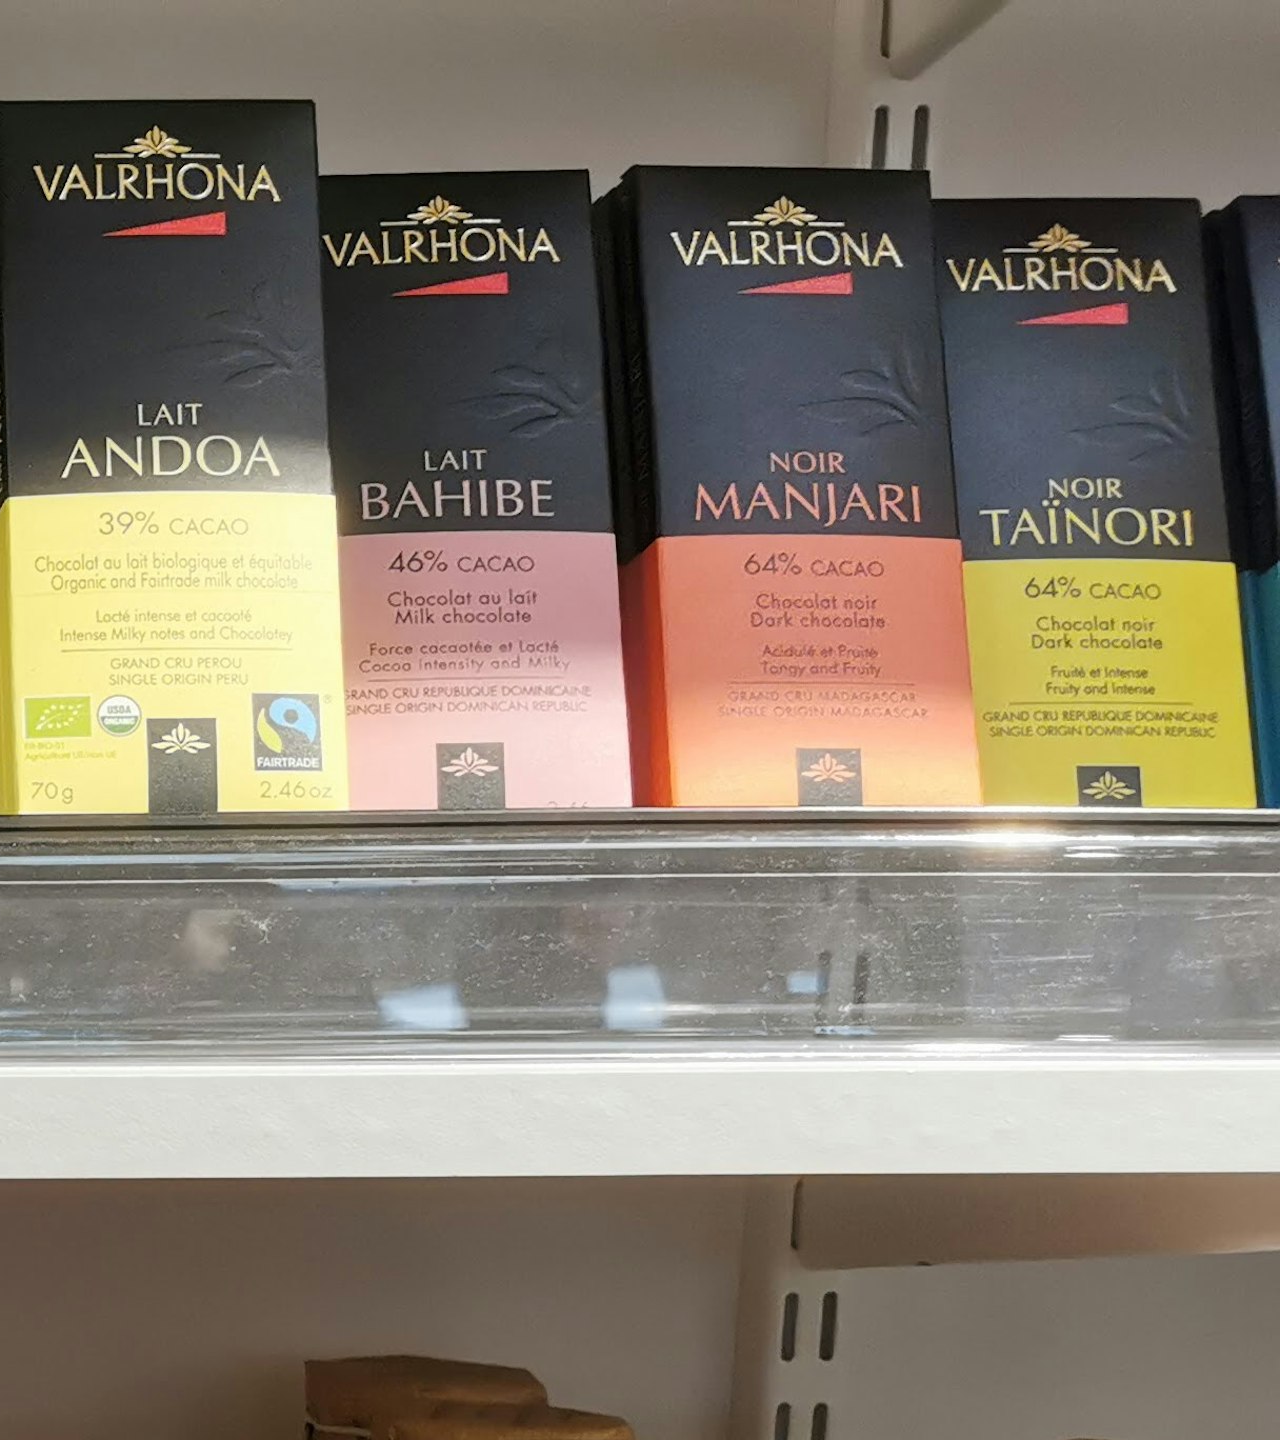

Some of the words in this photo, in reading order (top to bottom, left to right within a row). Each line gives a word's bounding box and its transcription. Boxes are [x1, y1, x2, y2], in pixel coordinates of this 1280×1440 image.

[33, 163, 281, 202] VALRHONA
[322, 227, 561, 267] VALRHONA
[670, 231, 903, 267] VALRHONA
[946, 257, 1177, 293] VALRHONA
[137, 403, 203, 426] LAIT
[61, 435, 281, 478] ANDOA
[424, 449, 488, 471] LAIT
[770, 451, 846, 474] NOIR
[360, 478, 556, 520] BAHIBE
[1048, 478, 1124, 499] NOIR
[695, 482, 921, 527] MANJARI
[98, 511, 159, 535] 39%
[168, 518, 249, 536] CACAO
[979, 500, 1193, 546] TAÏNORI
[388, 550, 448, 573] 46%
[457, 556, 535, 572] CACAO
[744, 552, 802, 576] 64%
[811, 559, 884, 577] CACAO
[1024, 577, 1081, 598] 64%
[1089, 583, 1162, 600] CACAO
[394, 608, 435, 625] Milk
[442, 609, 532, 624] chocolate
[1031, 634, 1072, 650] Dark
[1080, 634, 1163, 650] chocolate
[257, 756, 319, 768] FAIRTRADE
